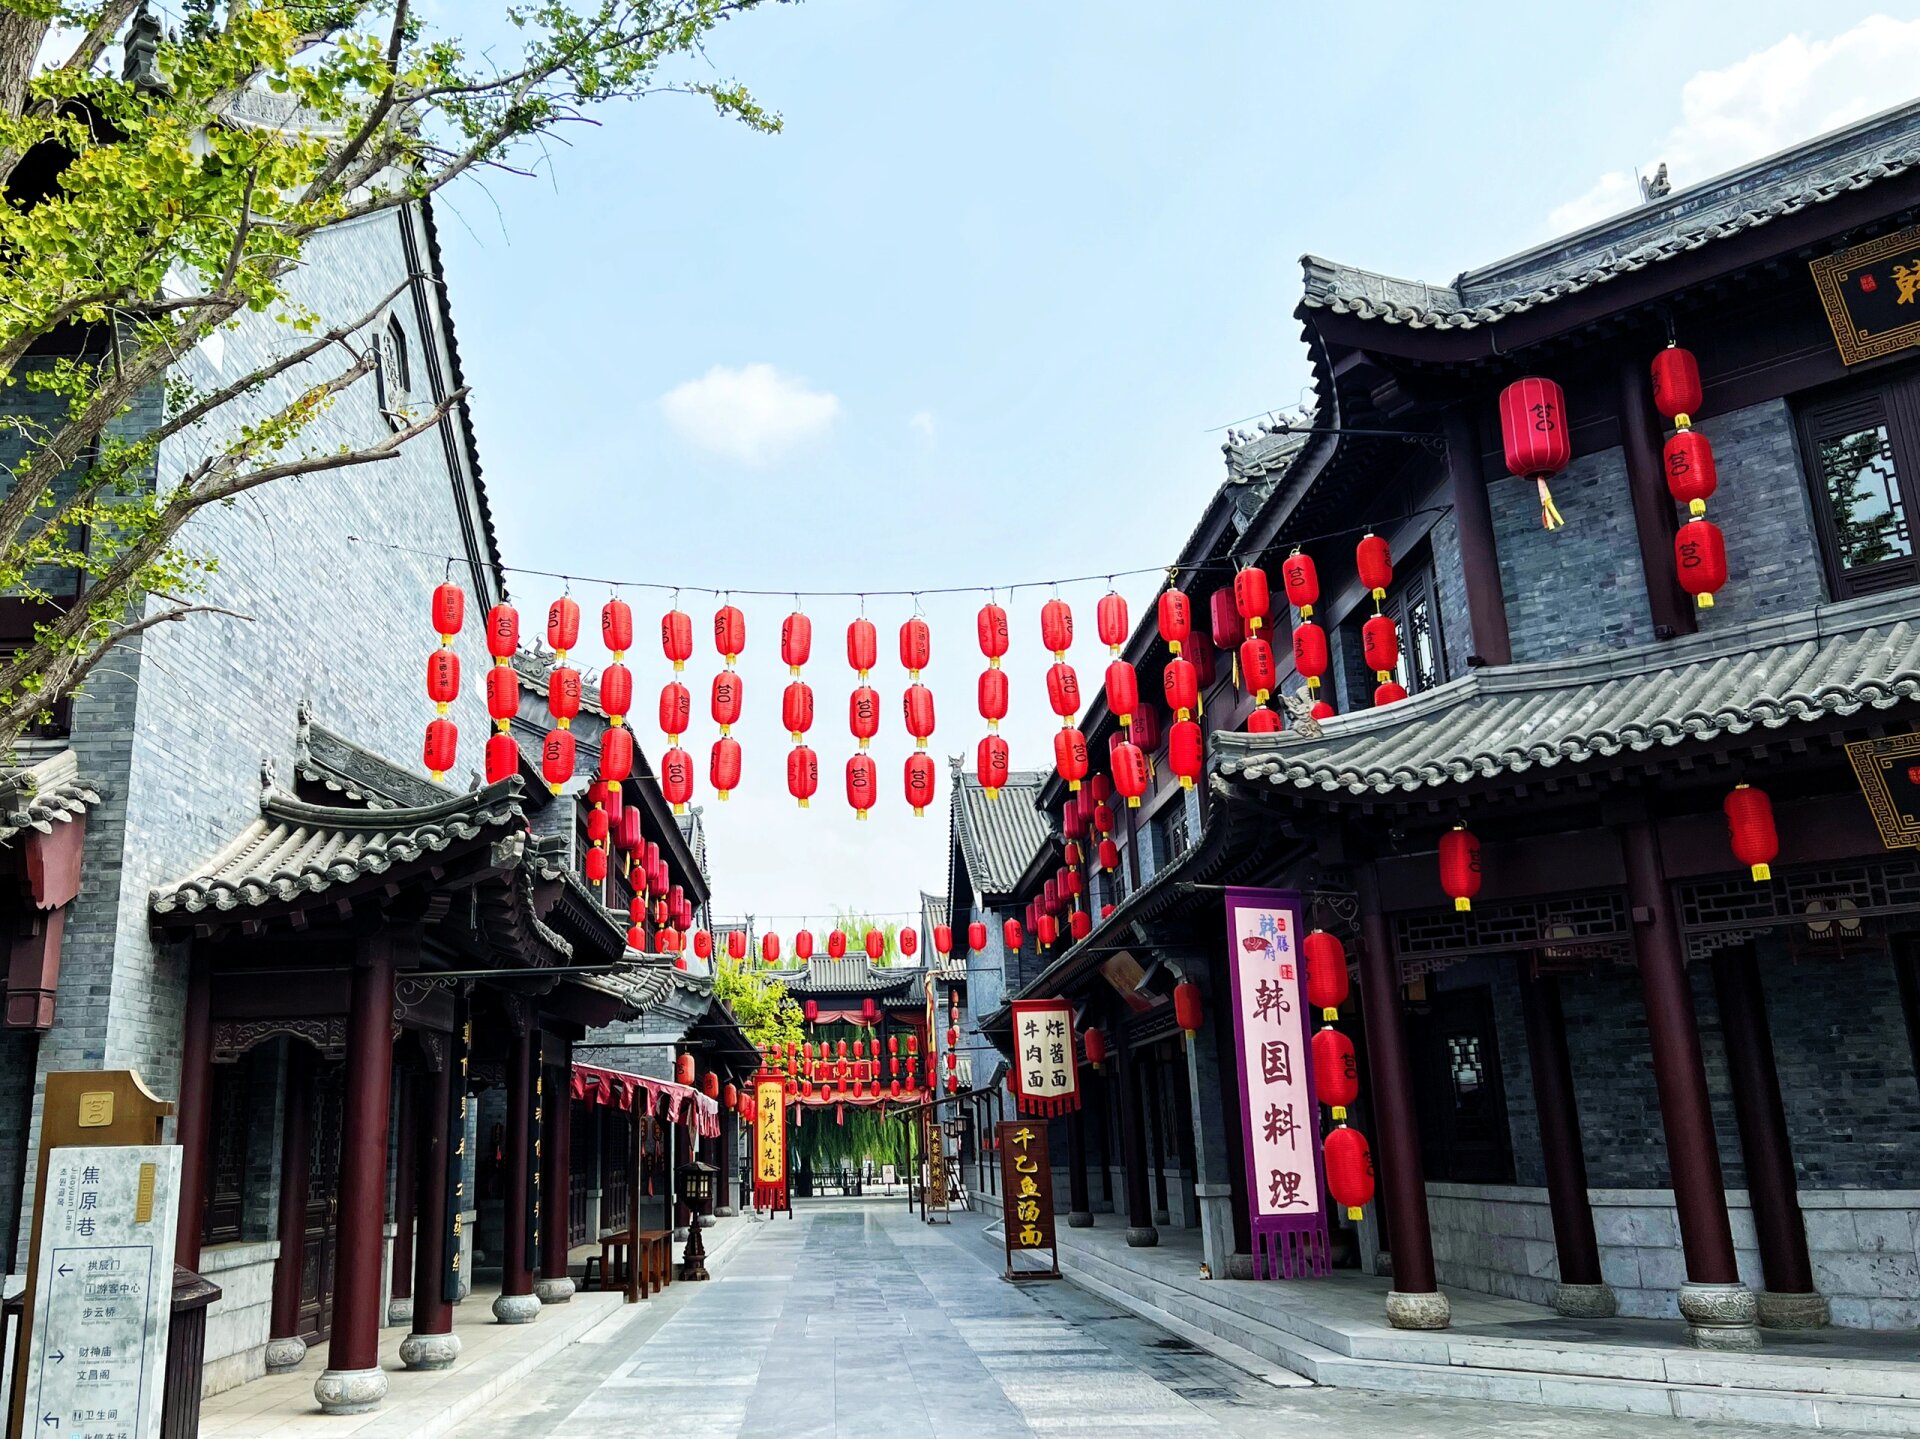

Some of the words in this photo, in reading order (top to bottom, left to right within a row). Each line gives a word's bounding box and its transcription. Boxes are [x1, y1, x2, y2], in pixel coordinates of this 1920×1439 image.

[1024, 1019, 1044, 1088] 牛肉面
[1046, 1018, 1067, 1087] 炸酱面
[1253, 979, 1309, 1209] 韩国料理
[68, 1167, 78, 1207] Jiaoyuan
[76, 1165, 101, 1236] 焦原巷
[65, 1208, 75, 1231] Lane
[87, 1259, 121, 1271] 拱辰门
[96, 1283, 141, 1294] 游客中心
[82, 1306, 116, 1319] 步云桥
[79, 1345, 112, 1357] 财神庙
[76, 1369, 110, 1380] 文昌阁
[84, 1409, 118, 1420] 卫生间
